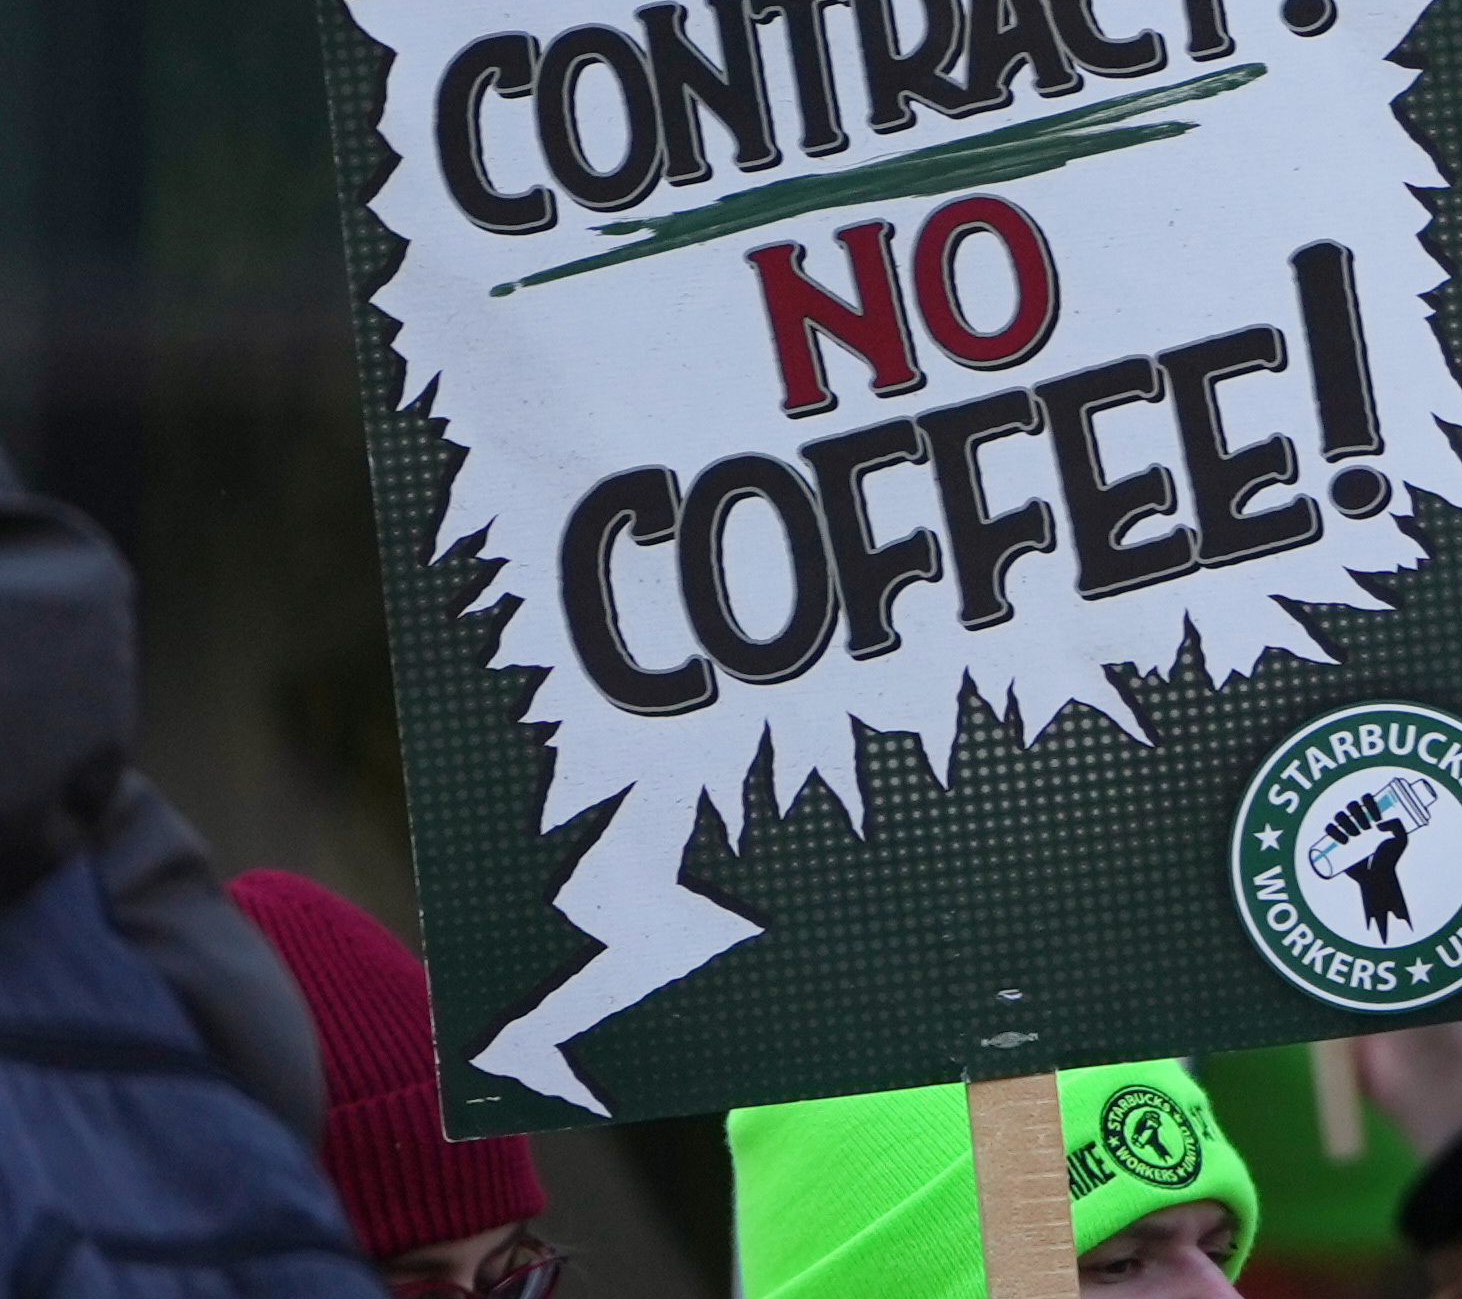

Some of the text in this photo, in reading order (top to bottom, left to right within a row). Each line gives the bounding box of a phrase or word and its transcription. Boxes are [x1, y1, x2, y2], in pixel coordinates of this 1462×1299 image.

[746, 192, 1062, 418] NO
[556, 241, 1394, 716] COFFEE!
[1252, 864, 1398, 992] WORKERS
[1106, 1091, 1173, 1131] STARBUCKS
[1115, 1144, 1179, 1183] WORKERS
